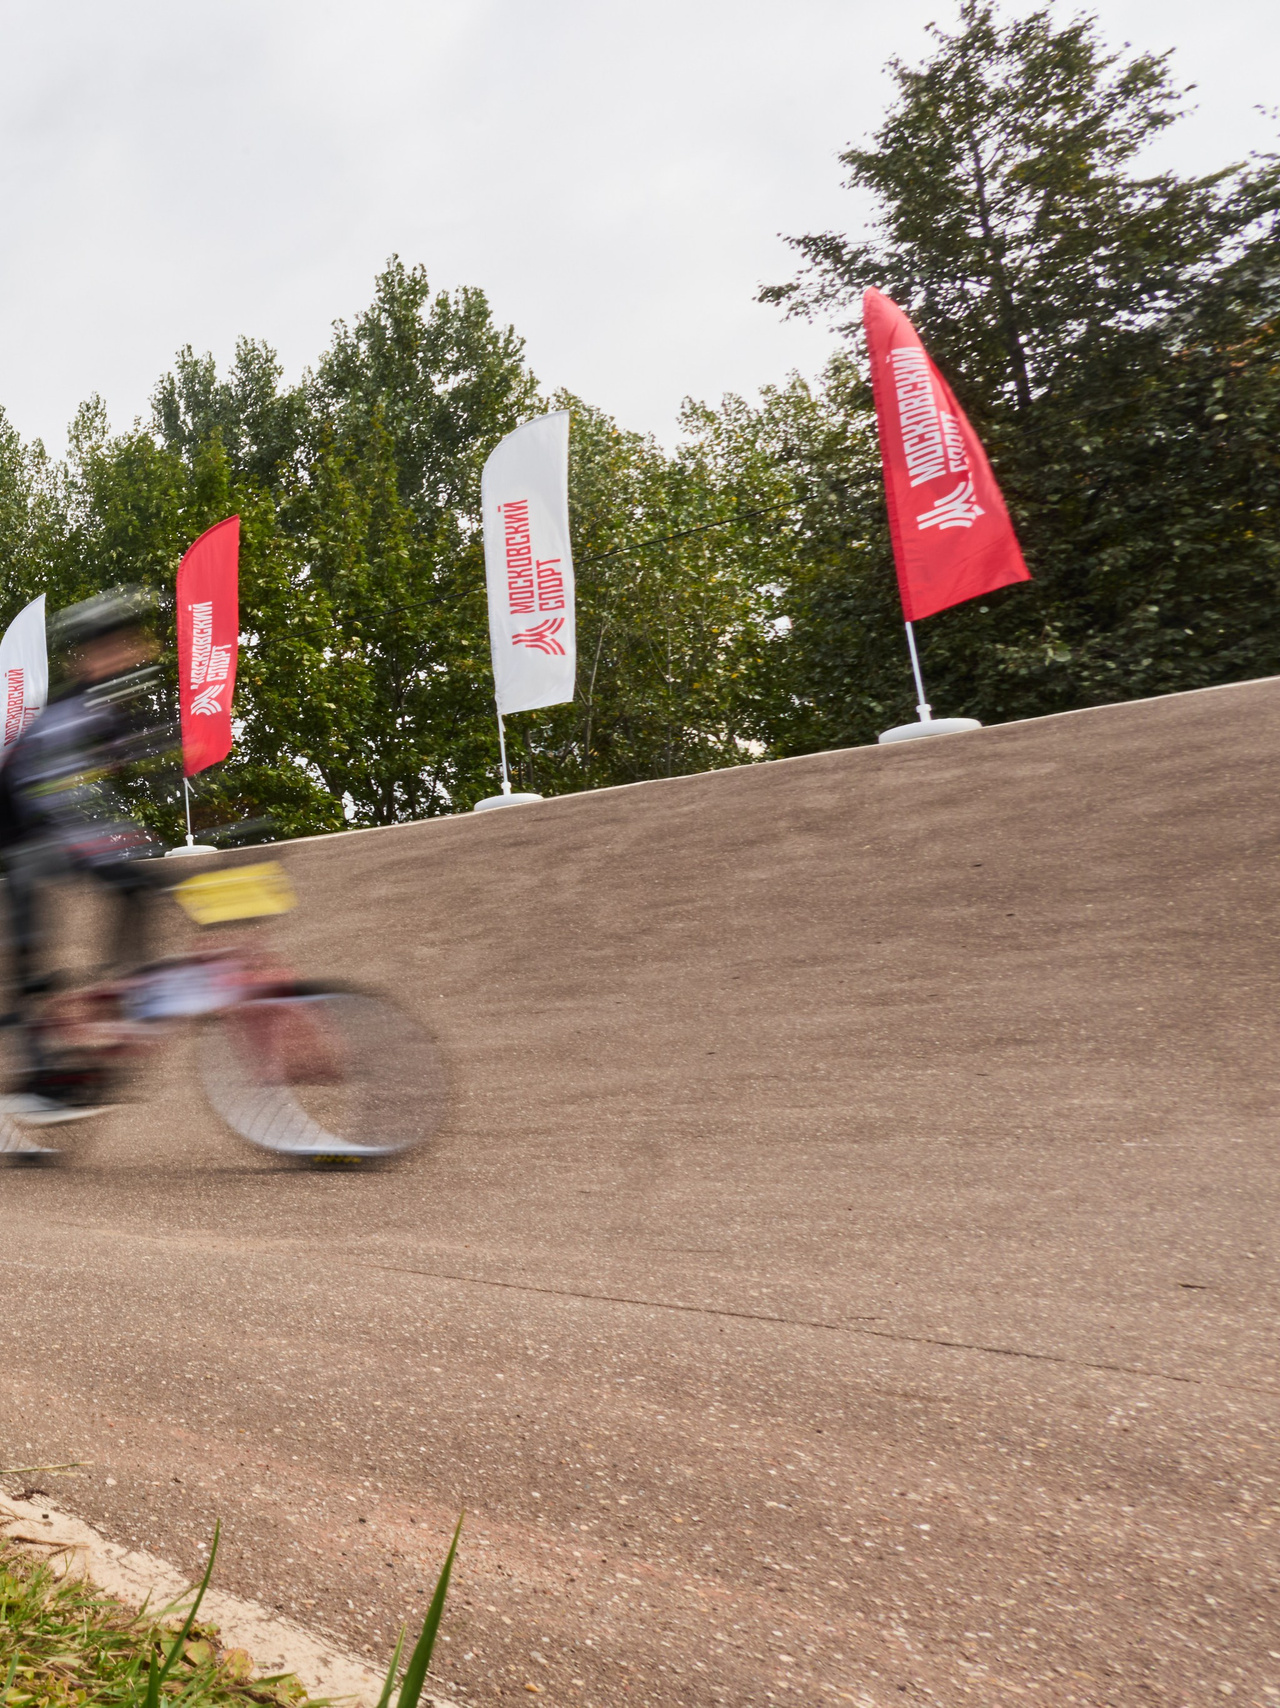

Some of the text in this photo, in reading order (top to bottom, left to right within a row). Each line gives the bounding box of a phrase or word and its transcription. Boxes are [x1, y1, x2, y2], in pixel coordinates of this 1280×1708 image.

[886, 346, 947, 488] МОСКОВСКИЙ
[497, 499, 536, 615] МОСКОВСКИЙ
[535, 558, 566, 612] СПОРТ
[206, 643, 232, 682] СПОРТ
[4, 667, 25, 747] МОСКОВСКИЙ
[21, 706, 40, 738] ПОРТ
